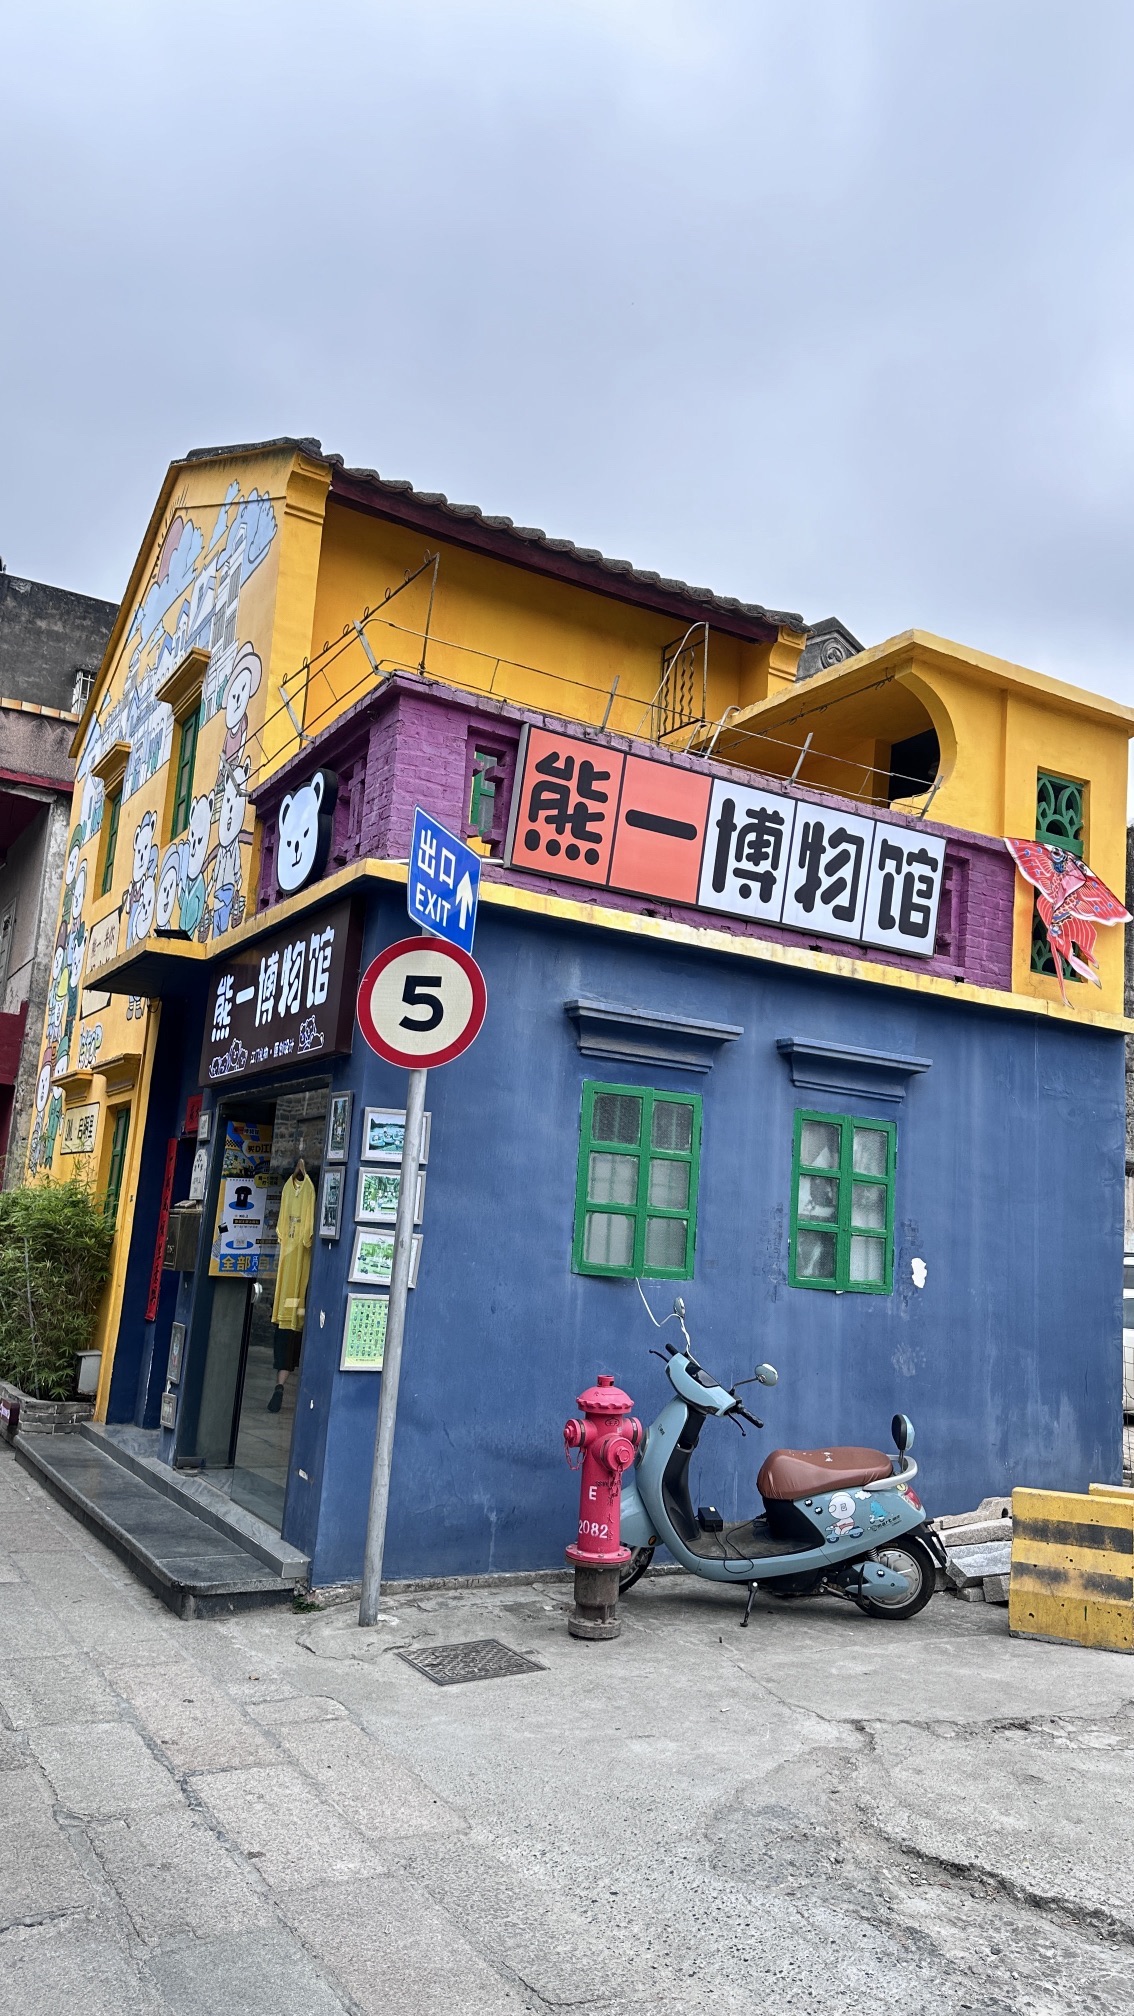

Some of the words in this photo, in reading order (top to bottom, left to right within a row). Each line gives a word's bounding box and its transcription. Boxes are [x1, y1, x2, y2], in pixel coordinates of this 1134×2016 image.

[417, 829, 456, 890] 出口
[528, 751, 939, 940] 熊一博物馆
[415, 882, 452, 927] EXIT
[211, 925, 335, 1043] 熊一博物馆
[398, 975, 444, 1032] 5
[589, 1485, 598, 1501] E
[578, 1519, 609, 1539] 2082
